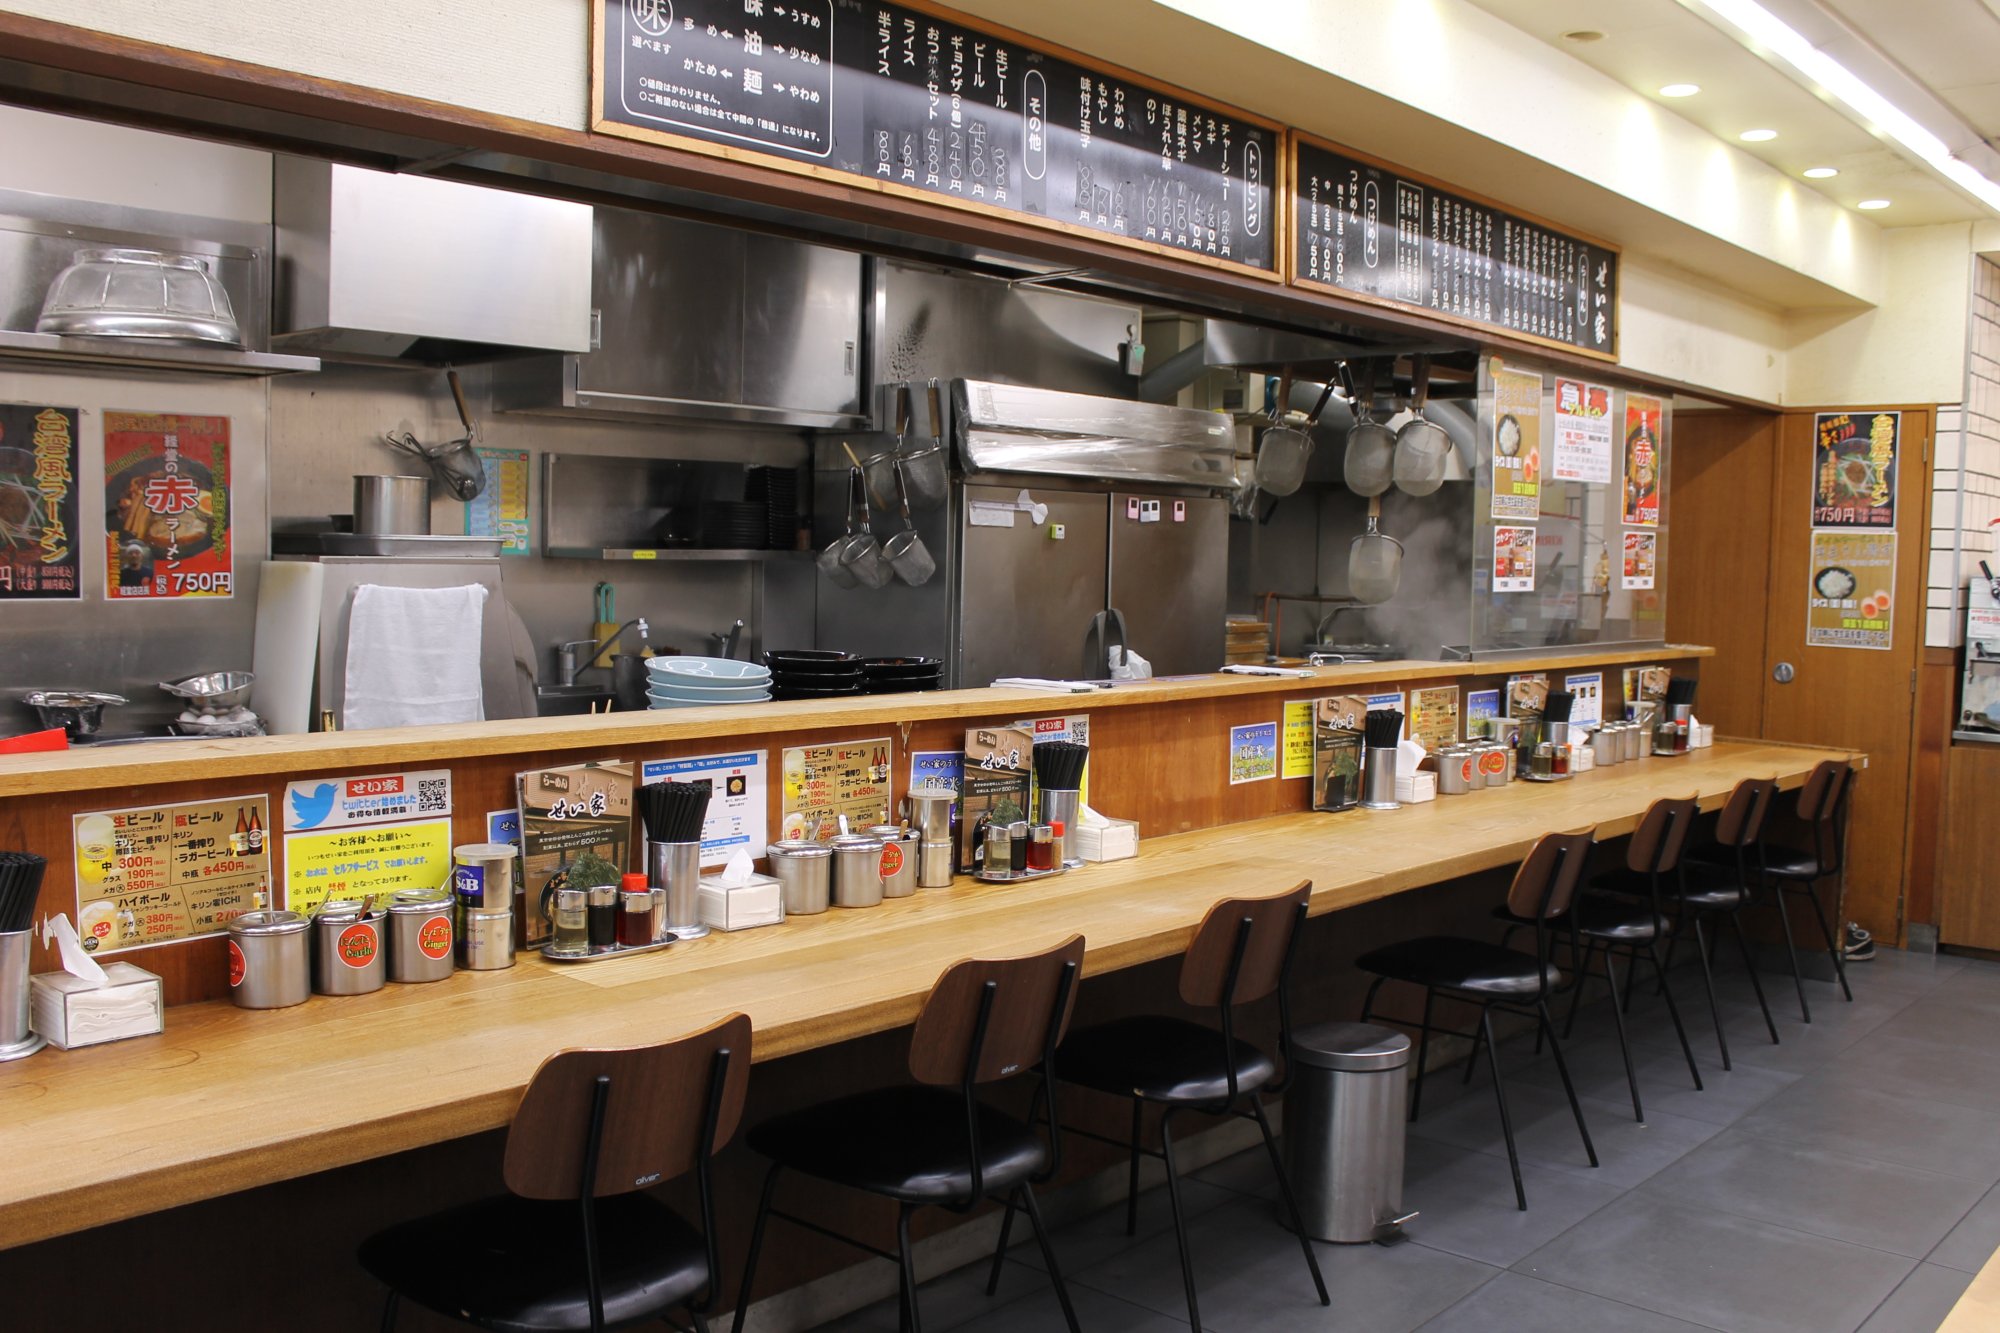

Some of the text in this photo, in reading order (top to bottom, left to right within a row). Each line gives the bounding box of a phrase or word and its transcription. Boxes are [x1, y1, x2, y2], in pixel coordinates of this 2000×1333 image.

[791, 9, 820, 29] うすめ
[631, 35, 672, 55] 選べます
[744, 28, 762, 56] 油
[790, 46, 820, 65] 少なめ
[878, 11, 891, 76] 半ライス
[903, 18, 915, 66] ライス
[974, 42, 986, 88] ビール
[683, 58, 717, 77] かため
[790, 85, 820, 104] やわめ
[995, 48, 1008, 109] 生ビール
[1080, 77, 1091, 149] 味付け玉子
[1098, 82, 1108, 125] もやし
[1114, 88, 1124, 130] わかめ
[1146, 98, 1156, 125] のり
[1028, 97, 1041, 152] その他
[1192, 115, 1201, 153] メンマ
[1206, 119, 1216, 145] ネギ
[1221, 124, 1231, 201] チャーシュー
[1248, 149, 1258, 228] トッピング
[1350, 170, 1358, 224] つけめん
[1367, 198, 1376, 254] つけめん
[171, 572, 231, 593] 750円
[1038, 720, 1062, 730] せい家
[804, 748, 833, 760] 生ビール
[981, 749, 1020, 770] せい家
[351, 779, 399, 794] せい家
[543, 774, 568, 789] らーめん
[806, 781, 826, 790] 300円
[342, 794, 417, 810] twitter始めました
[548, 794, 605, 819] せい家
[114, 811, 164, 828] 生ビール
[174, 811, 223, 827] 瓶ビール
[805, 808, 834, 819] ハイボール
[115, 834, 169, 848] キリン一番搾り
[173, 831, 193, 840] キリン
[102, 862, 112, 872] 中
[119, 856, 153, 869] 300円
[203, 861, 245, 876] 各450円
[333, 860, 379, 875] セルフサービス
[102, 869, 154, 884] グラス 190円
[127, 880, 155, 891] 550円
[118, 893, 170, 908] ハイボール
[146, 913, 173, 925] 380円
[122, 924, 174, 939] グラス 250円
[423, 938, 449, 950] Ginger
